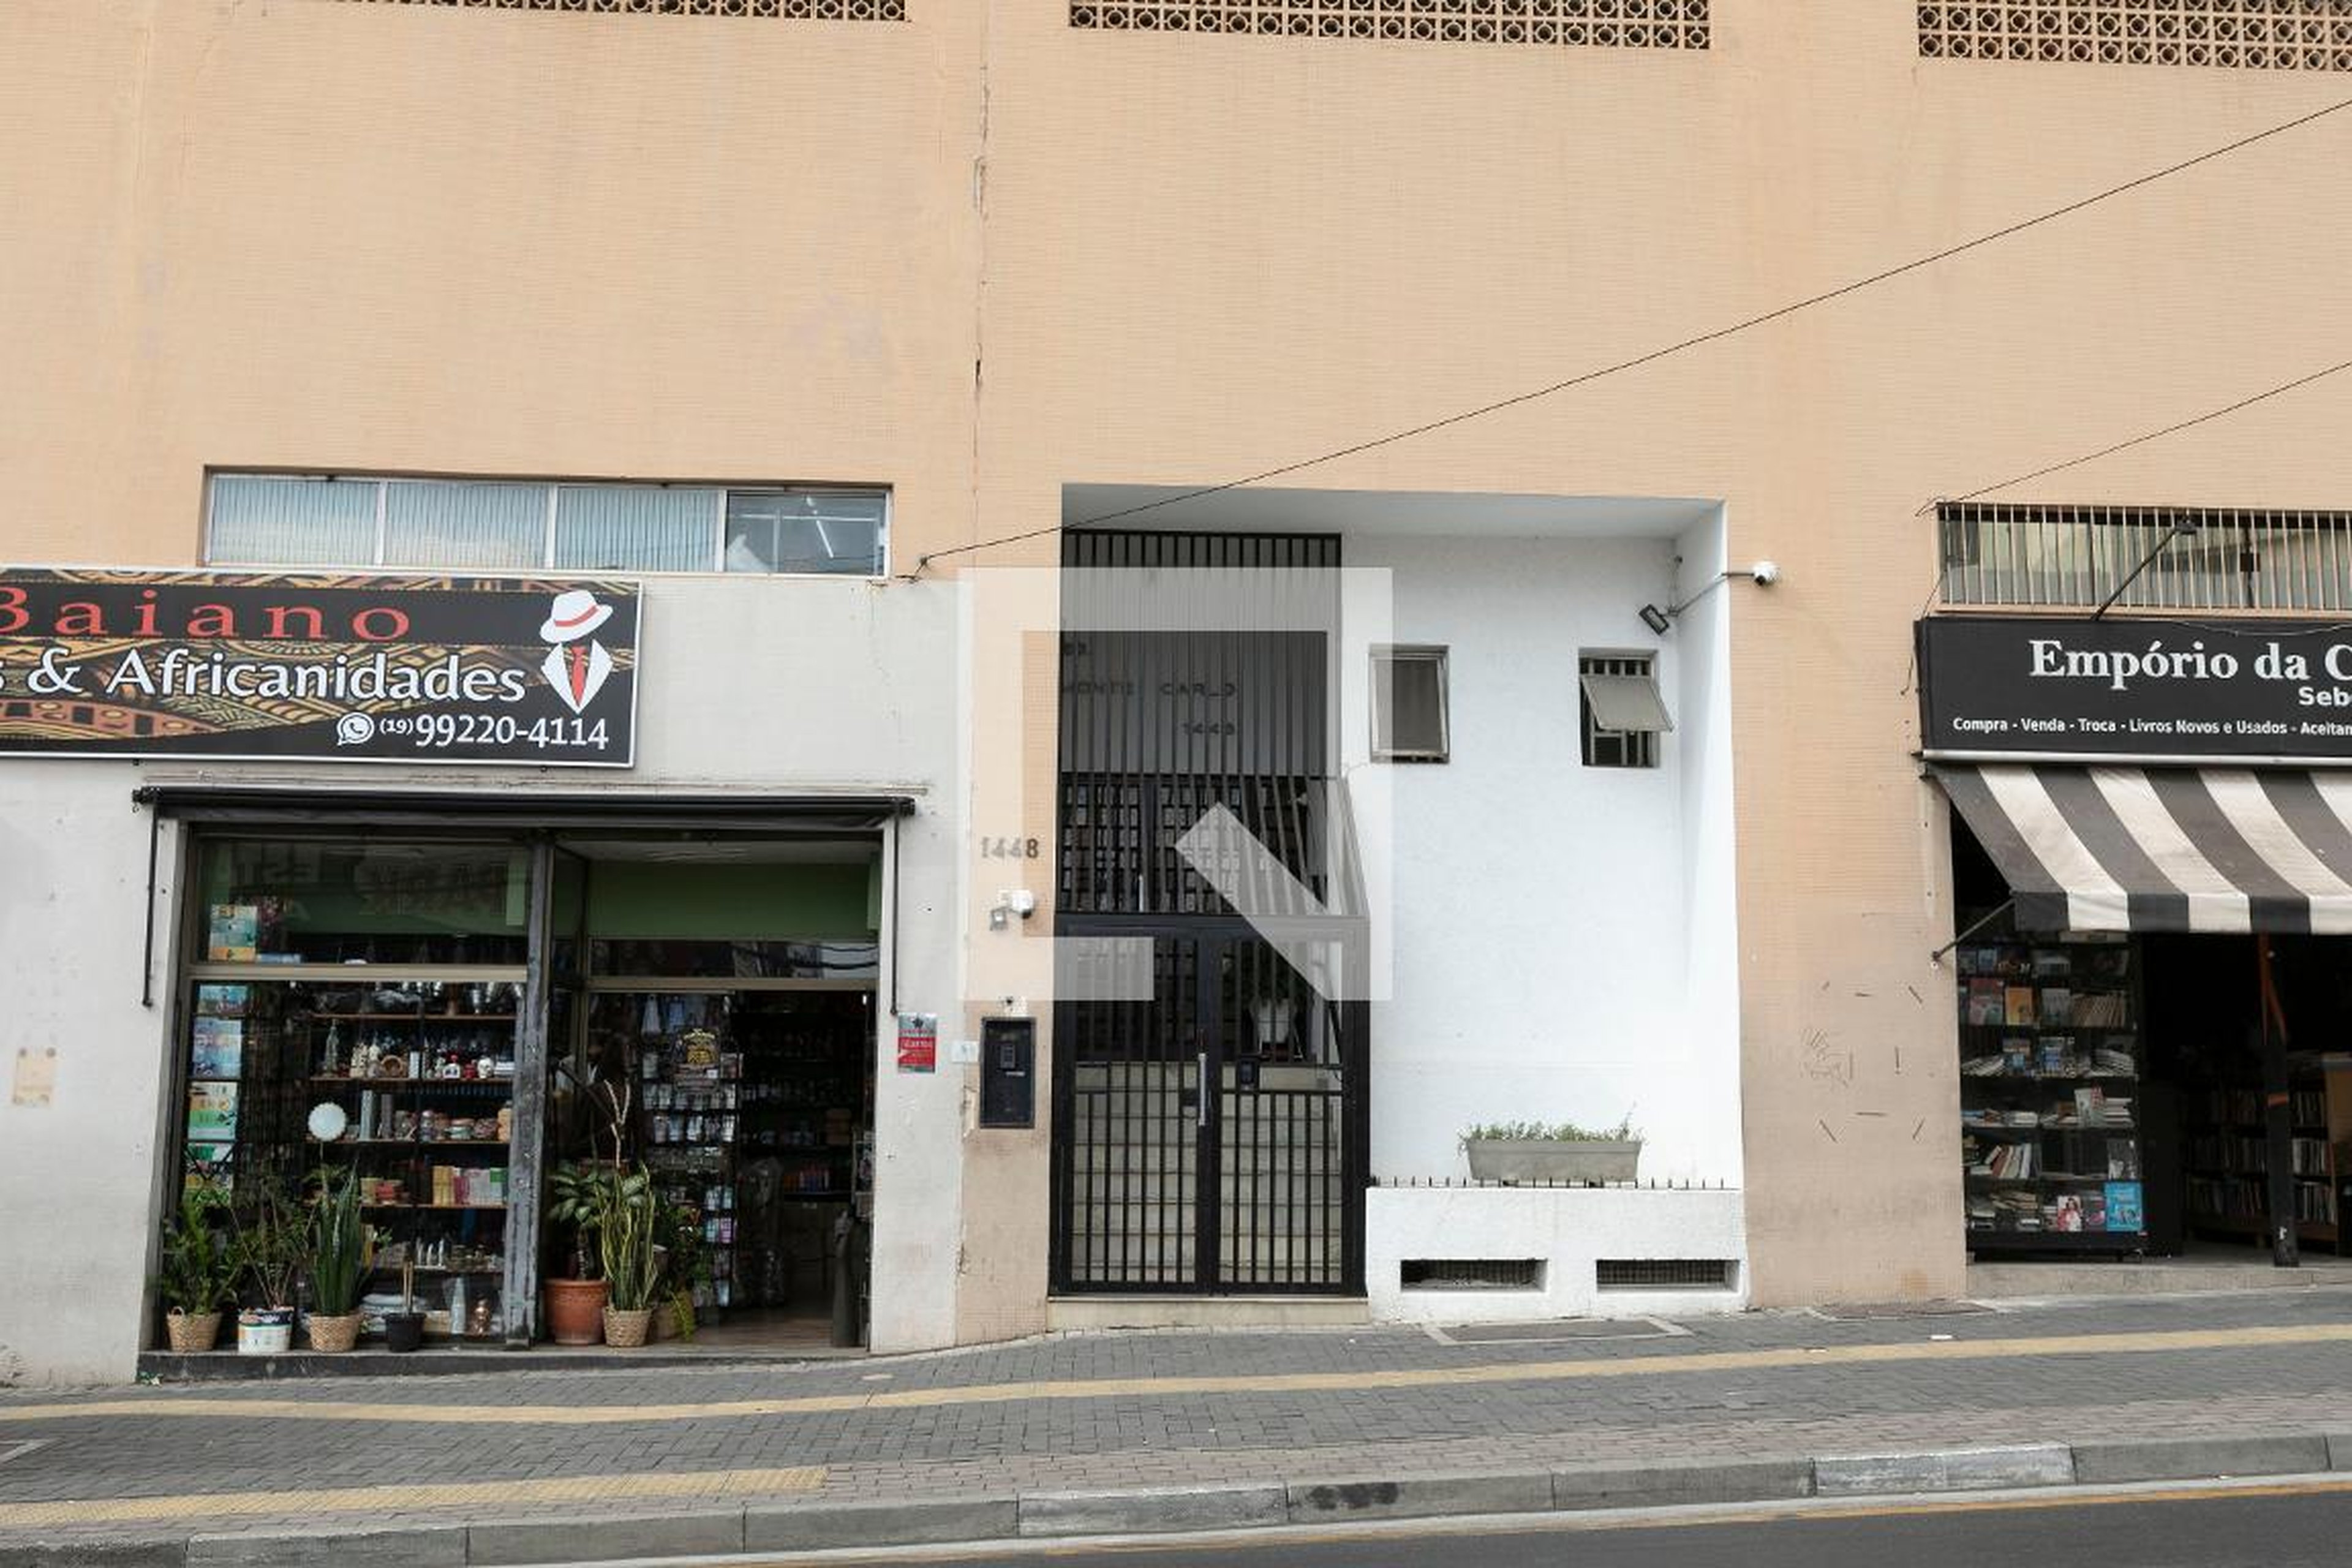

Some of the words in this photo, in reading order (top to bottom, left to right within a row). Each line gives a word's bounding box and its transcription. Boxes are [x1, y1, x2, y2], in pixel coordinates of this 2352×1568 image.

[28, 647, 84, 693] &
[105, 647, 526, 703] Africanidades
[2029, 639, 2239, 690] Empório
[2254, 642, 2311, 680] da
[2298, 685, 2352, 707] Seb
[416, 714, 609, 750] 99220-4114
[1953, 717, 2008, 734] Compra
[2021, 717, 2065, 732] Venda
[2078, 718, 2116, 733] Troca
[2129, 718, 2173, 733] Livros
[2176, 718, 2220, 734] Novos
[2223, 723, 2232, 734] e
[2236, 719, 2288, 734] Usados
[981, 837, 1039, 859] 1448
